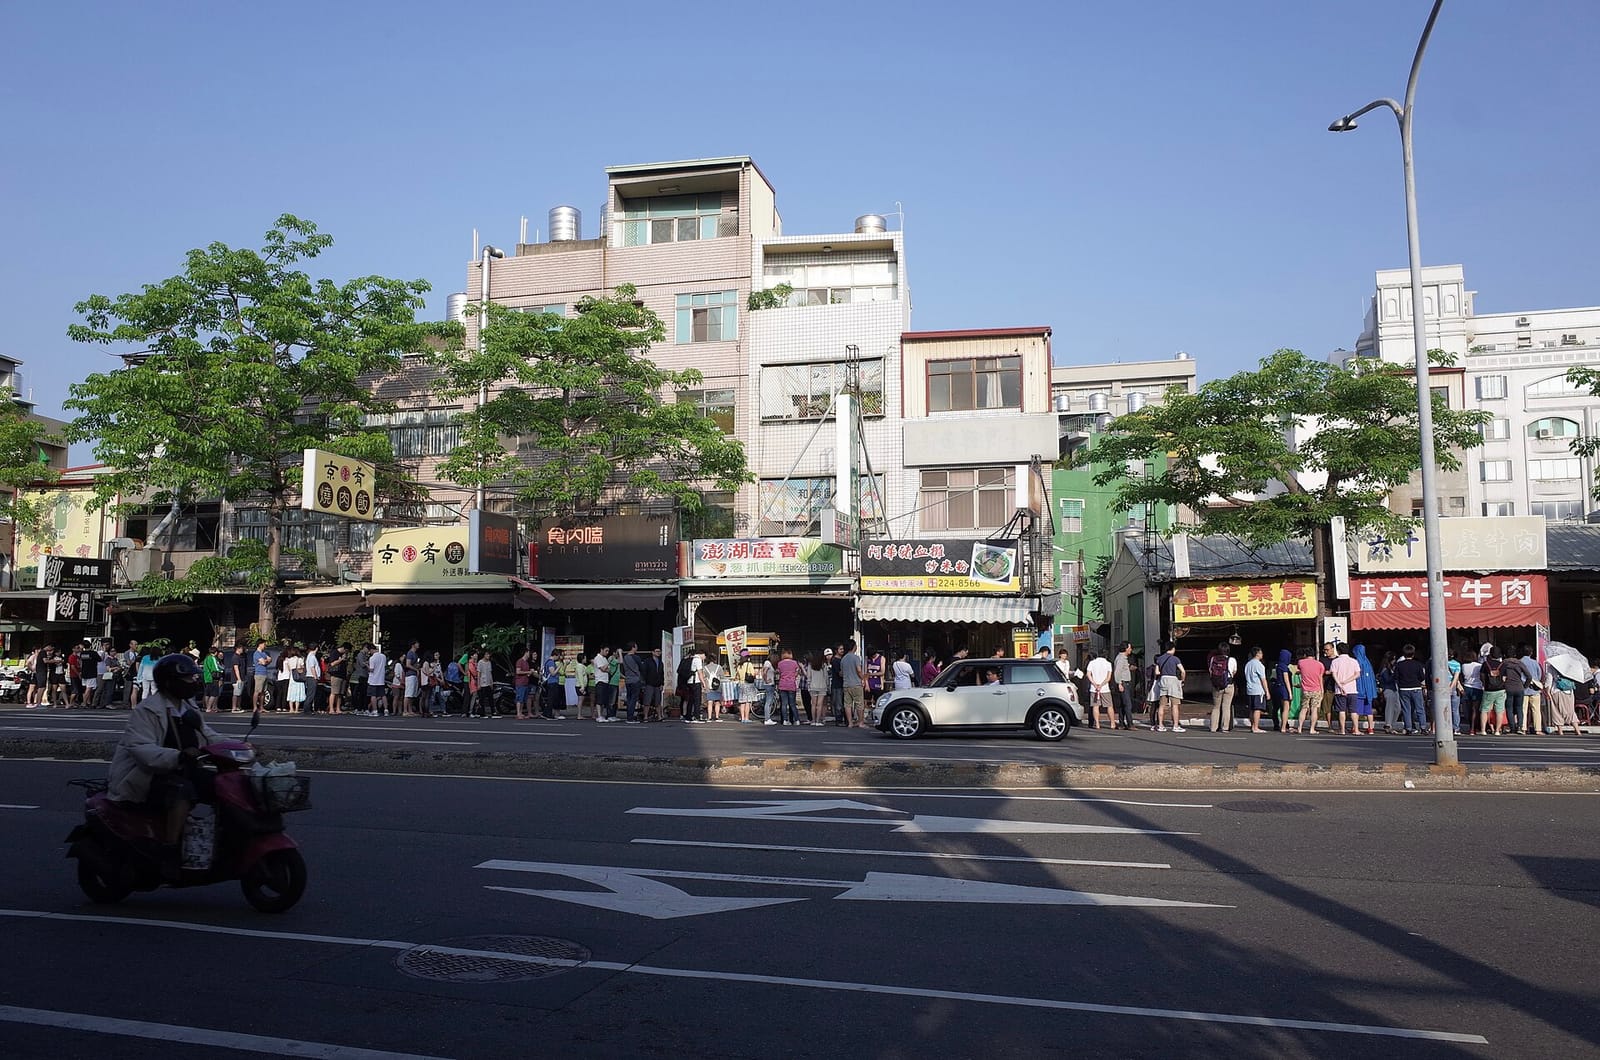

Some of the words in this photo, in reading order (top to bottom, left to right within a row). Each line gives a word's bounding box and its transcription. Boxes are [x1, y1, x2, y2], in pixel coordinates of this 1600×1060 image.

[320, 485, 368, 511] 燒肉飯
[702, 542, 799, 560] 澎湖蘆薈
[925, 559, 970, 574] 炒米粉
